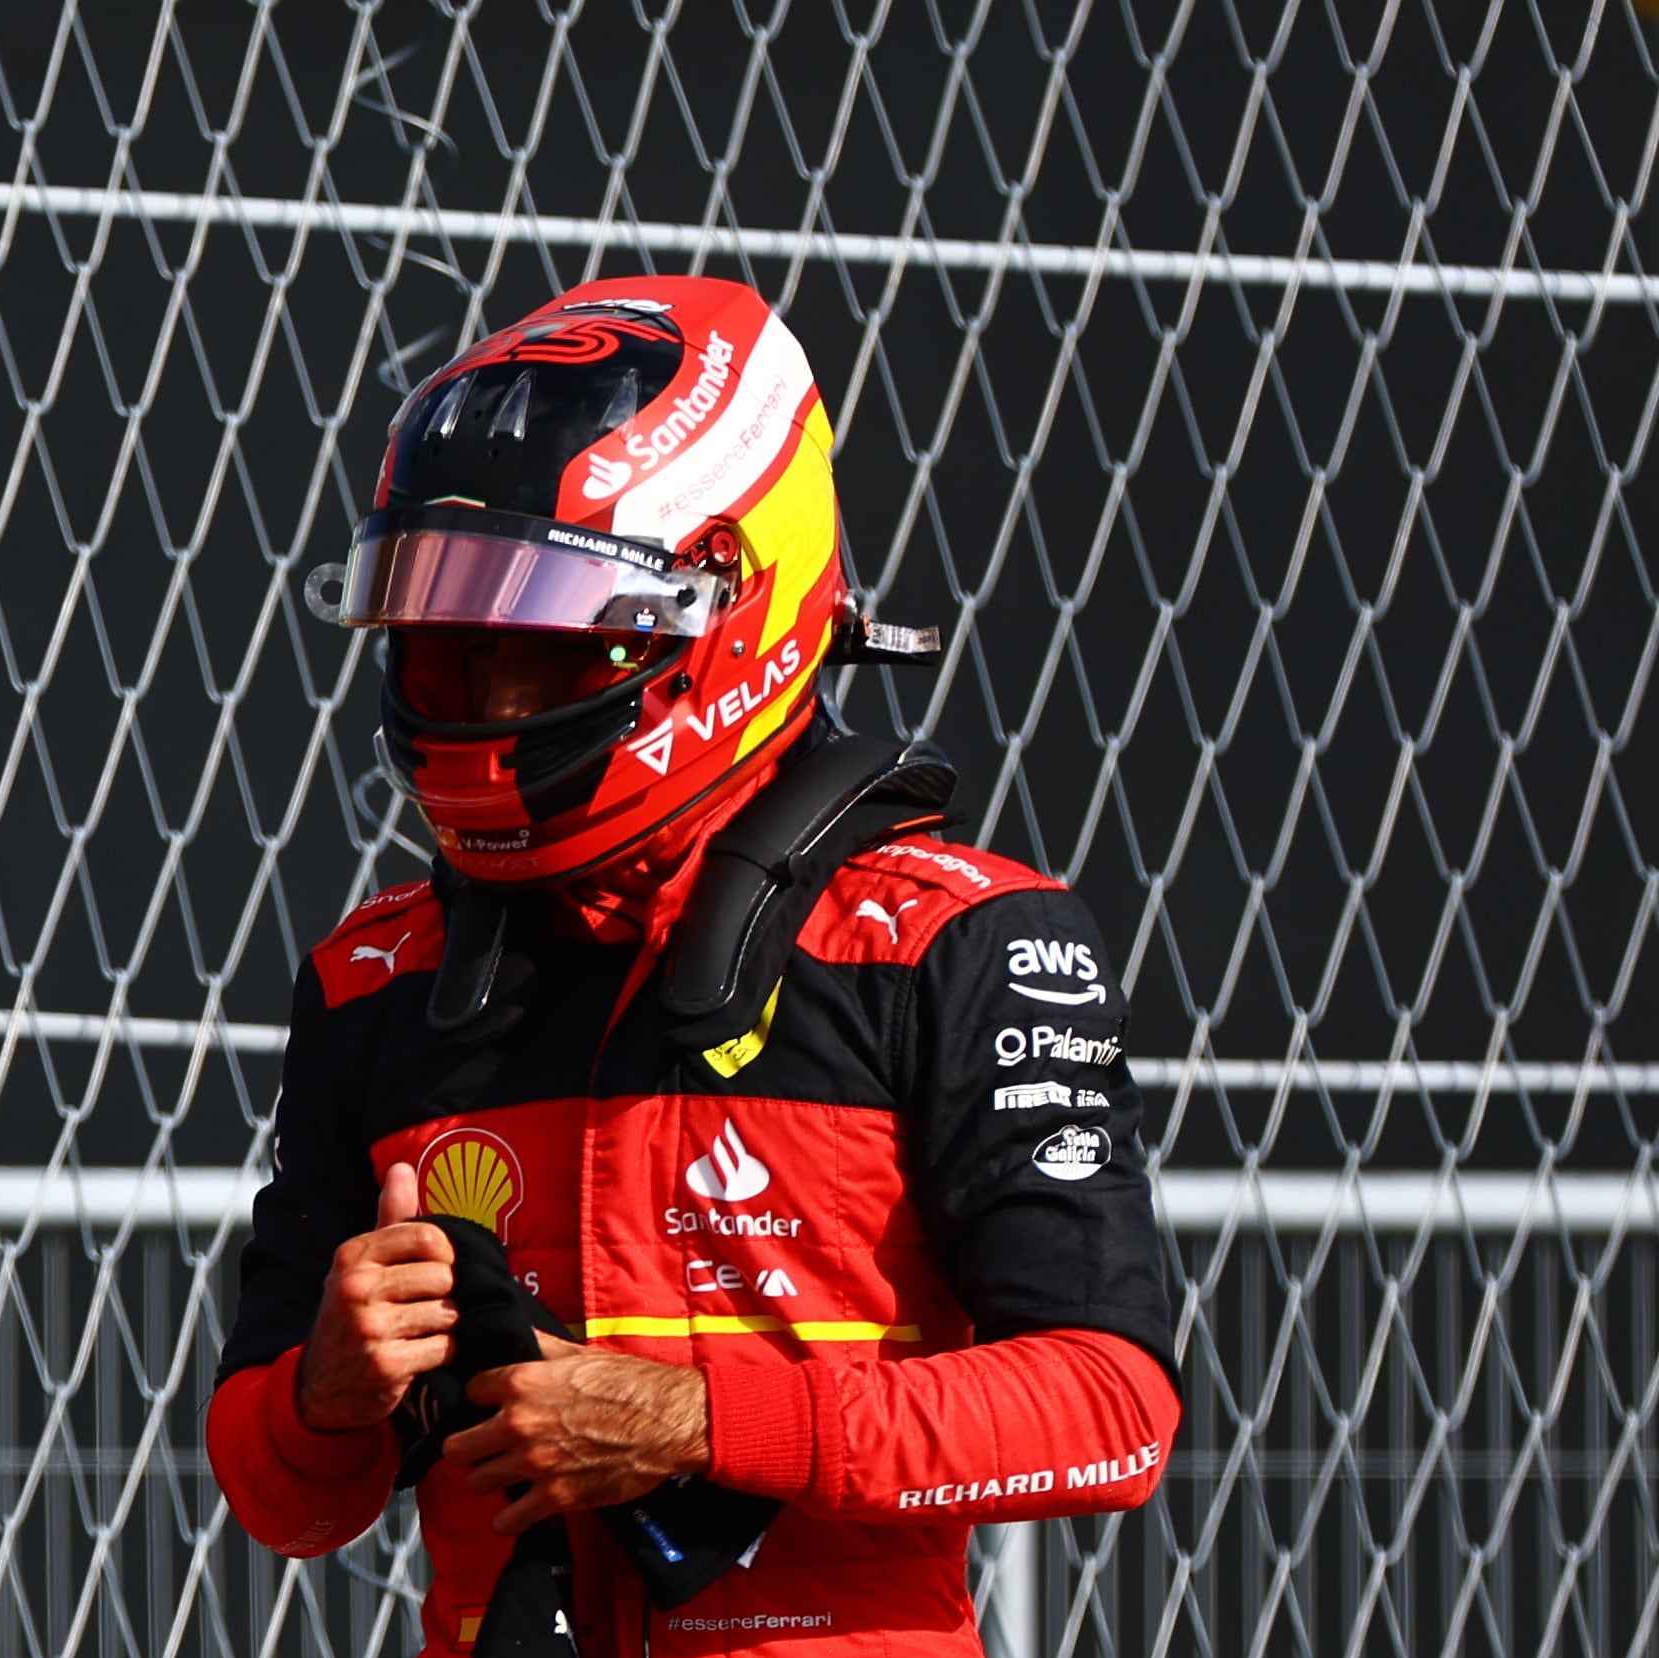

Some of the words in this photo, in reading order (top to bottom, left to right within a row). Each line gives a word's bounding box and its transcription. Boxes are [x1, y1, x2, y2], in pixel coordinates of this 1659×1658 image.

[626, 330, 735, 471] Santander
[657, 377, 789, 521] #essereFerrari
[547, 528, 618, 556] RICHARD
[620, 547, 665, 572] MILLE
[686, 638, 801, 741] VELAS
[1006, 938, 1100, 982] aws
[1032, 1025, 1124, 1067] Palantir
[664, 1207, 803, 1238] Santander
[898, 1470, 1055, 1510] RICHARD
[1067, 1441, 1161, 1490] MILLE
[667, 1611, 833, 1632] #essereFerrari
